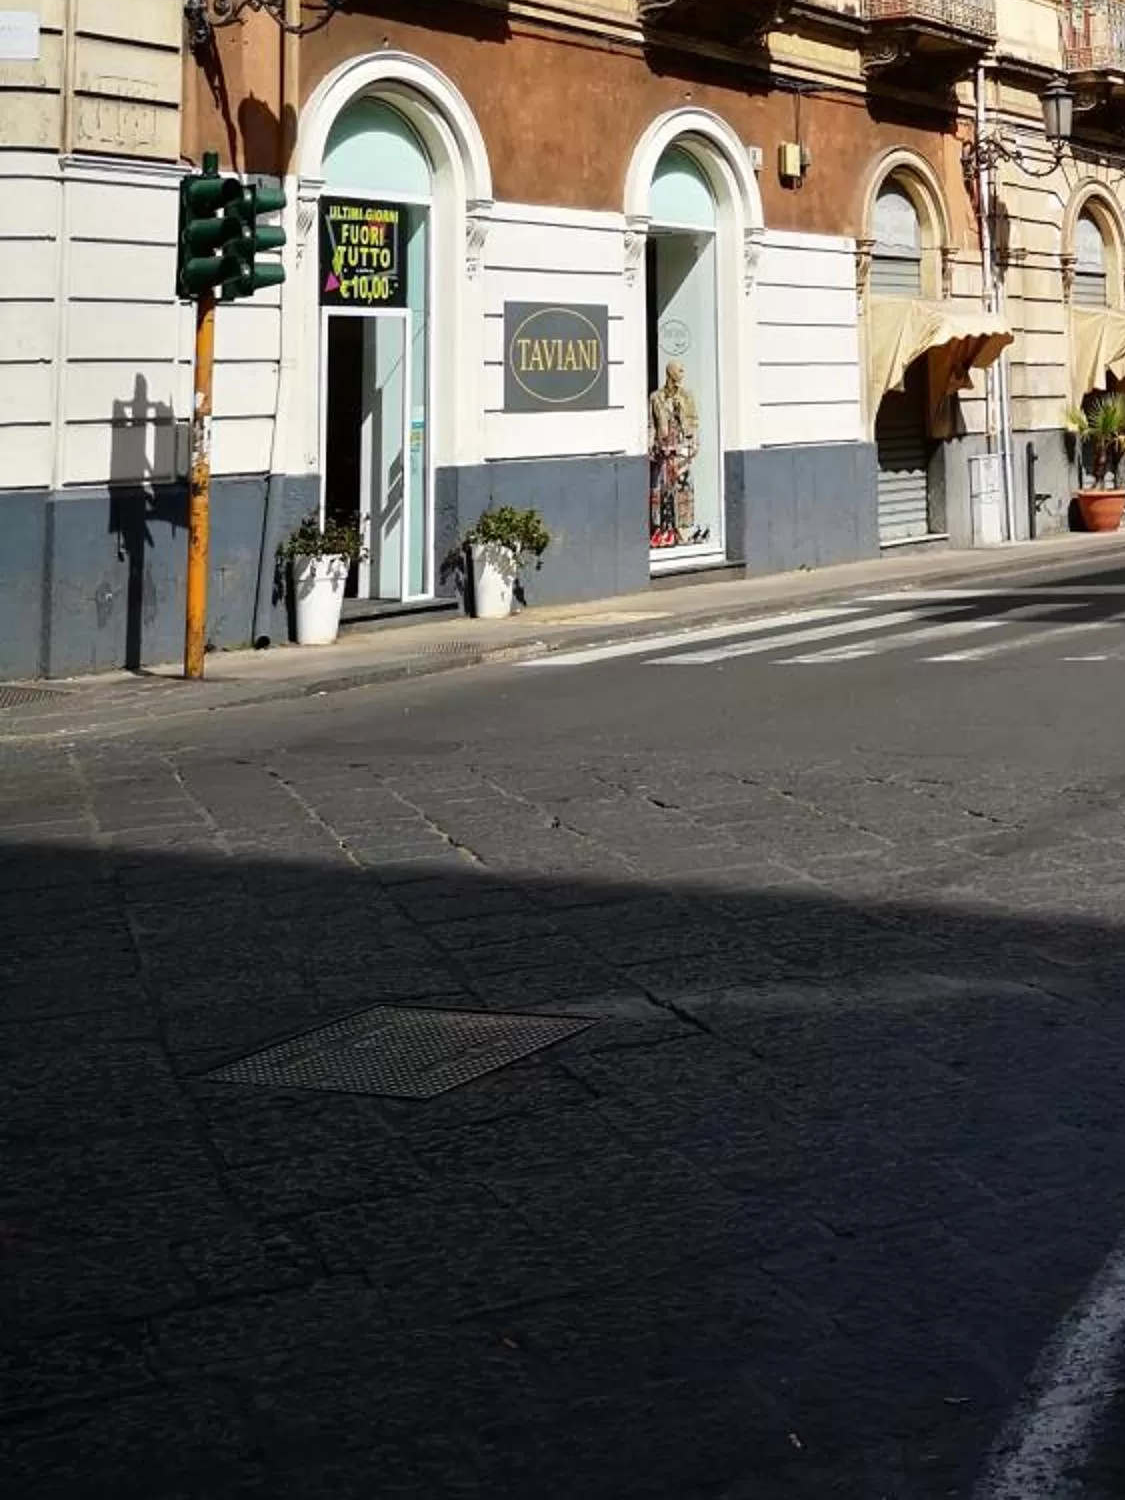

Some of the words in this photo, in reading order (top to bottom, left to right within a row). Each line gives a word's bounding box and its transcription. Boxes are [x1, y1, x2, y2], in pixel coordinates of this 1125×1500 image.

[329, 205, 363, 220] ULTIMI
[365, 208, 399, 223] GIORNI
[341, 223, 385, 246] FUORI
[336, 245, 391, 268] TUTTO
[340, 275, 389, 305] €10,00
[516, 338, 598, 372] TAVIANI
